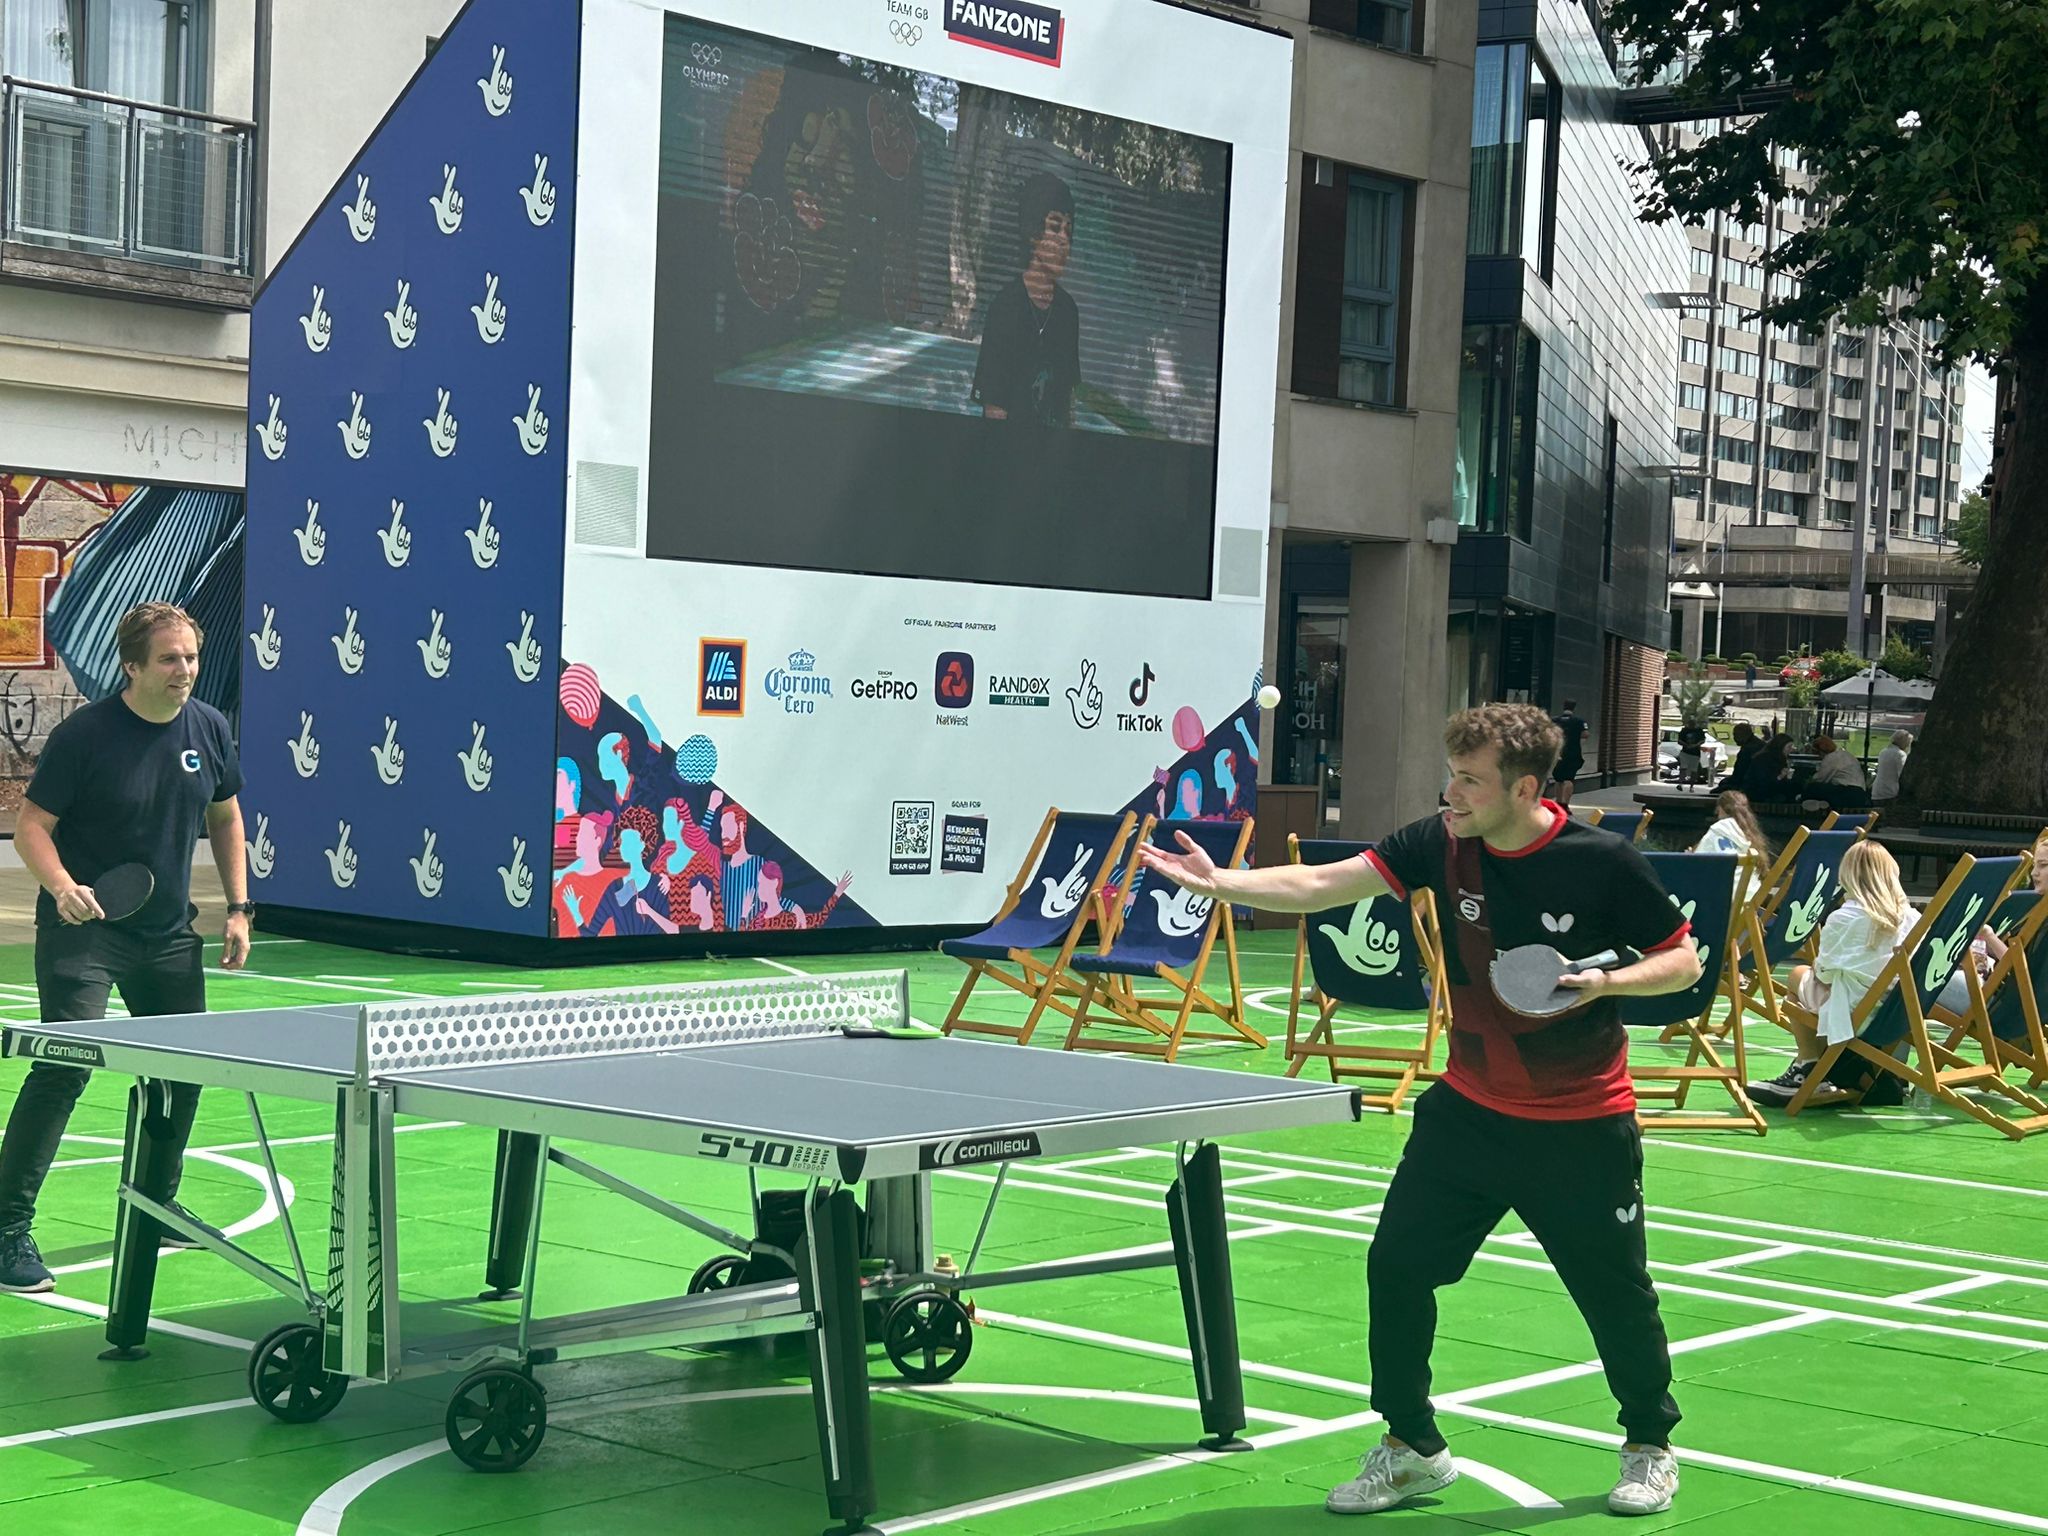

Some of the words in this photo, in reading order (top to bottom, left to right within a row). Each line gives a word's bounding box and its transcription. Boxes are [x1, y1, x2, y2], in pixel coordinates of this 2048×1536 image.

[887, 0, 913, 17] TEAM
[915, 6, 929, 20] GB
[951, 0, 1052, 44] FANZONE
[705, 686, 737, 701] ALDI
[764, 667, 832, 701] Corona
[851, 679, 918, 700] GetPRO
[989, 676, 1050, 695] RANDOX
[784, 695, 814, 714] Cero
[1004, 696, 1036, 706] HEALTH
[936, 714, 969, 727] NatWest
[1117, 714, 1162, 732] TikTok
[181, 749, 200, 772] G
[698, 1132, 794, 1167] 540
[959, 1138, 1030, 1159] cornilleau
